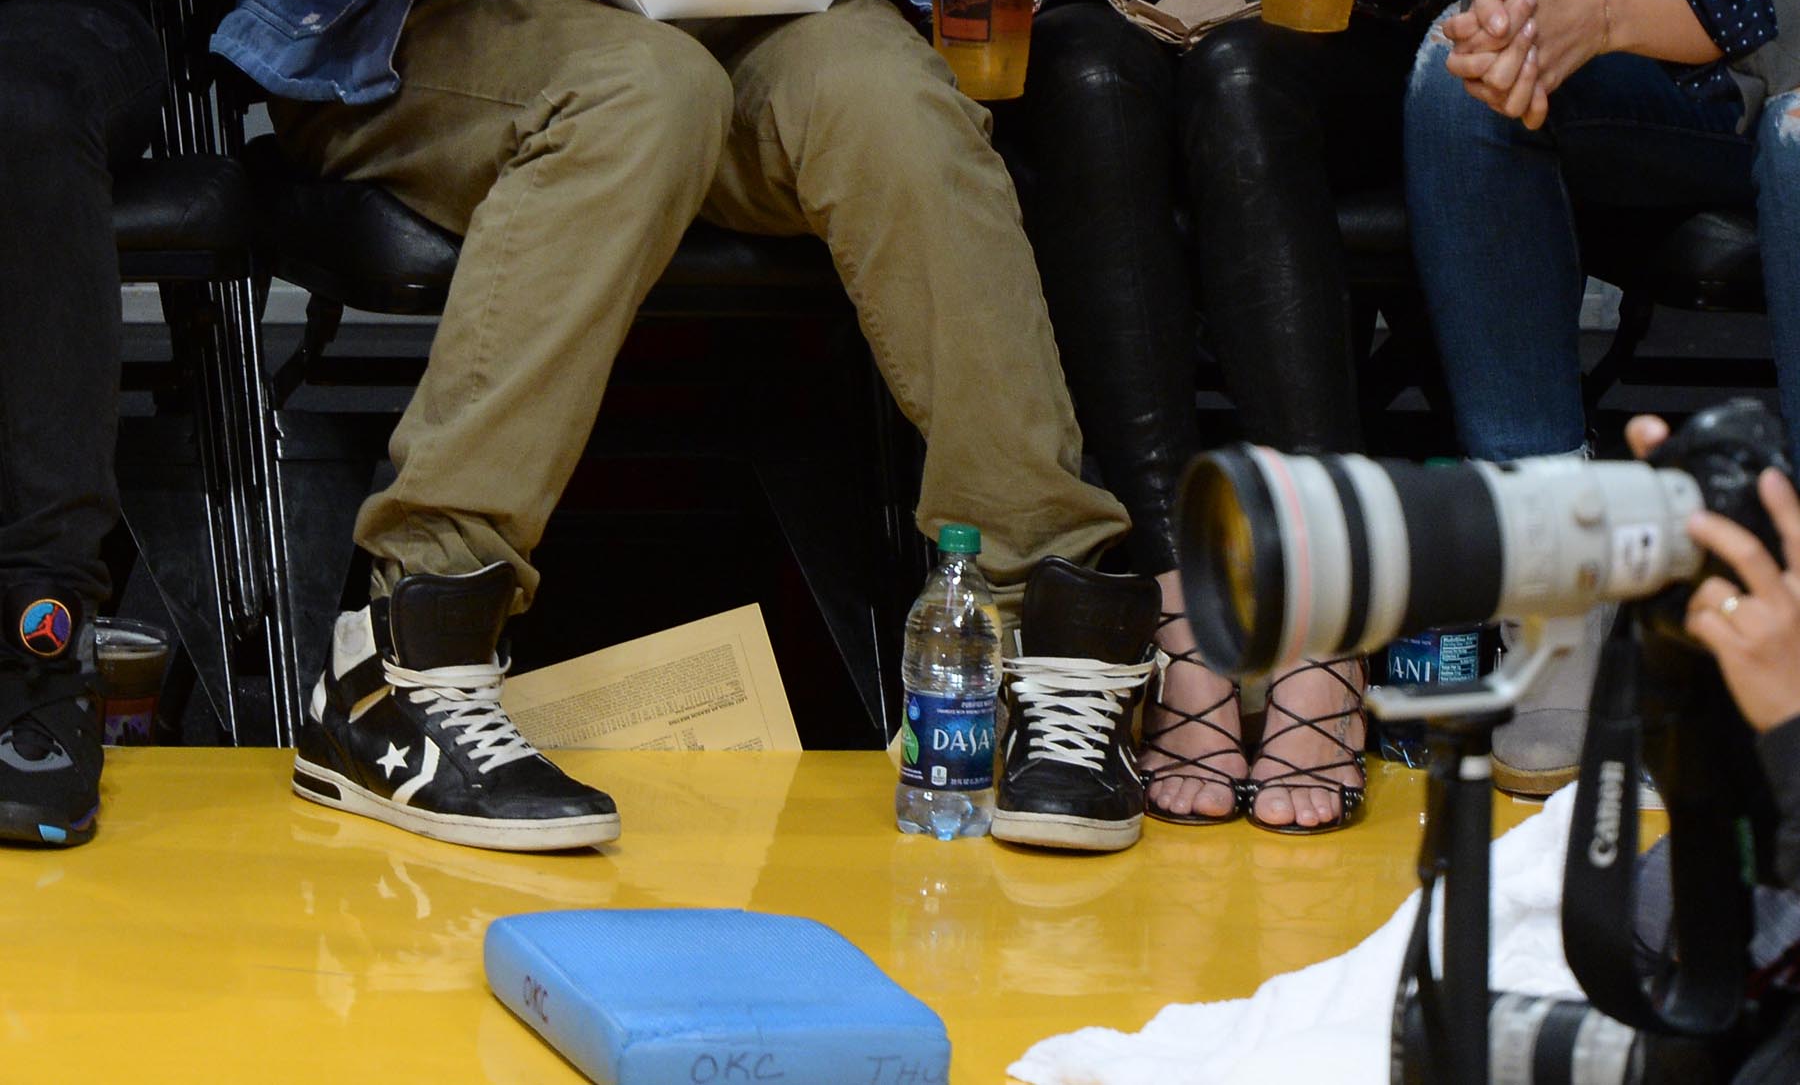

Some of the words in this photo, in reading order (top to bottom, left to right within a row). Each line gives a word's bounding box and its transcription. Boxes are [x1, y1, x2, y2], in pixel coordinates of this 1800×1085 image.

[1388, 656, 1431, 683] ANI
[1588, 760, 1625, 868] Canon
[522, 974, 549, 1025] OKC
[690, 1052, 784, 1085] OKC
